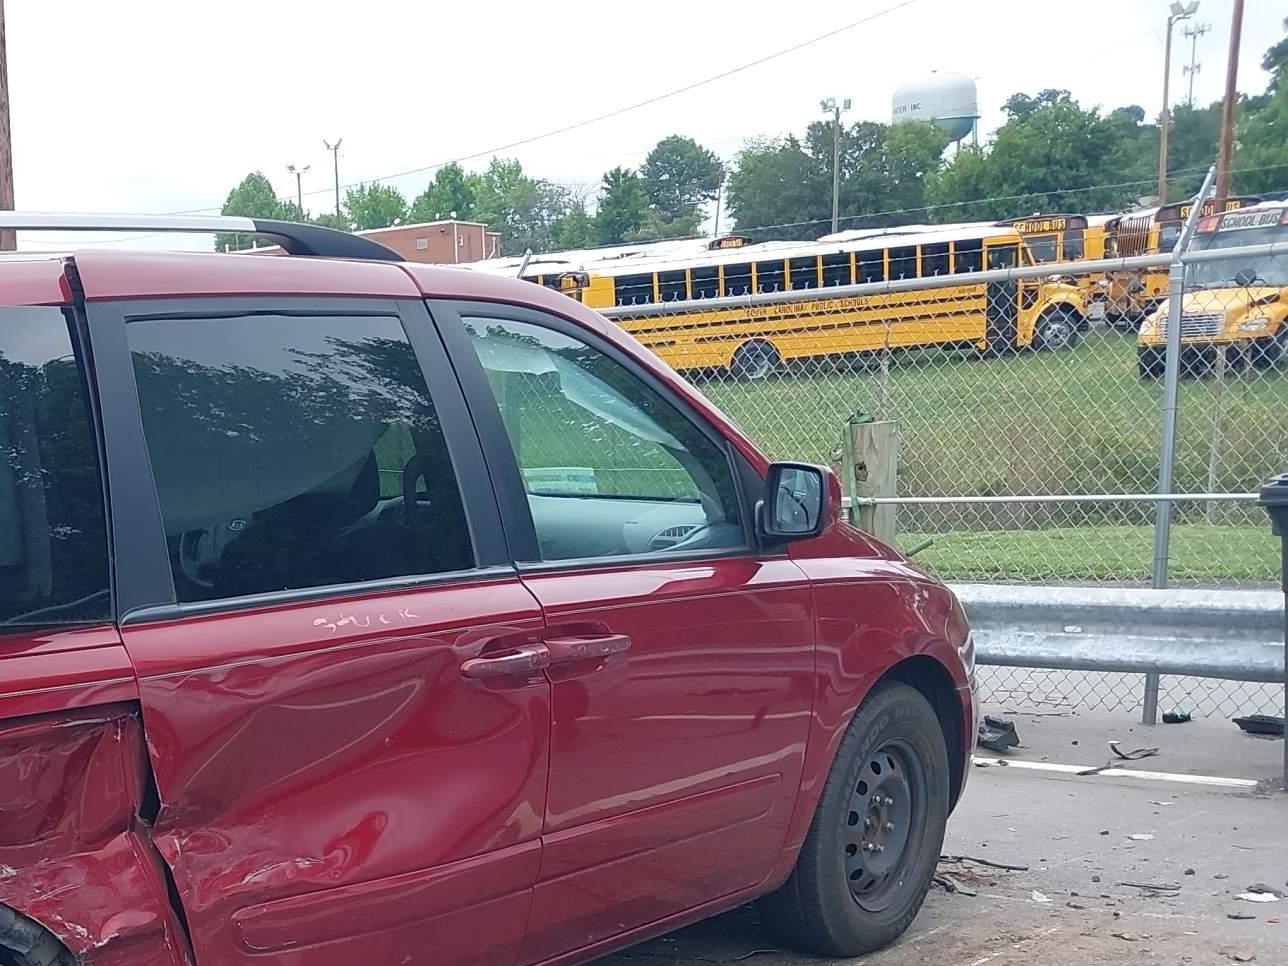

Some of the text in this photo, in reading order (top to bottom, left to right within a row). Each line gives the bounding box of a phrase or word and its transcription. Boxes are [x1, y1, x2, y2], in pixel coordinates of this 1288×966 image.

[1221, 213, 1280, 229] SCHOOL BUS
[746, 298, 869, 317] SOUTH CAROLINA PUBLIC SCHOOLS
